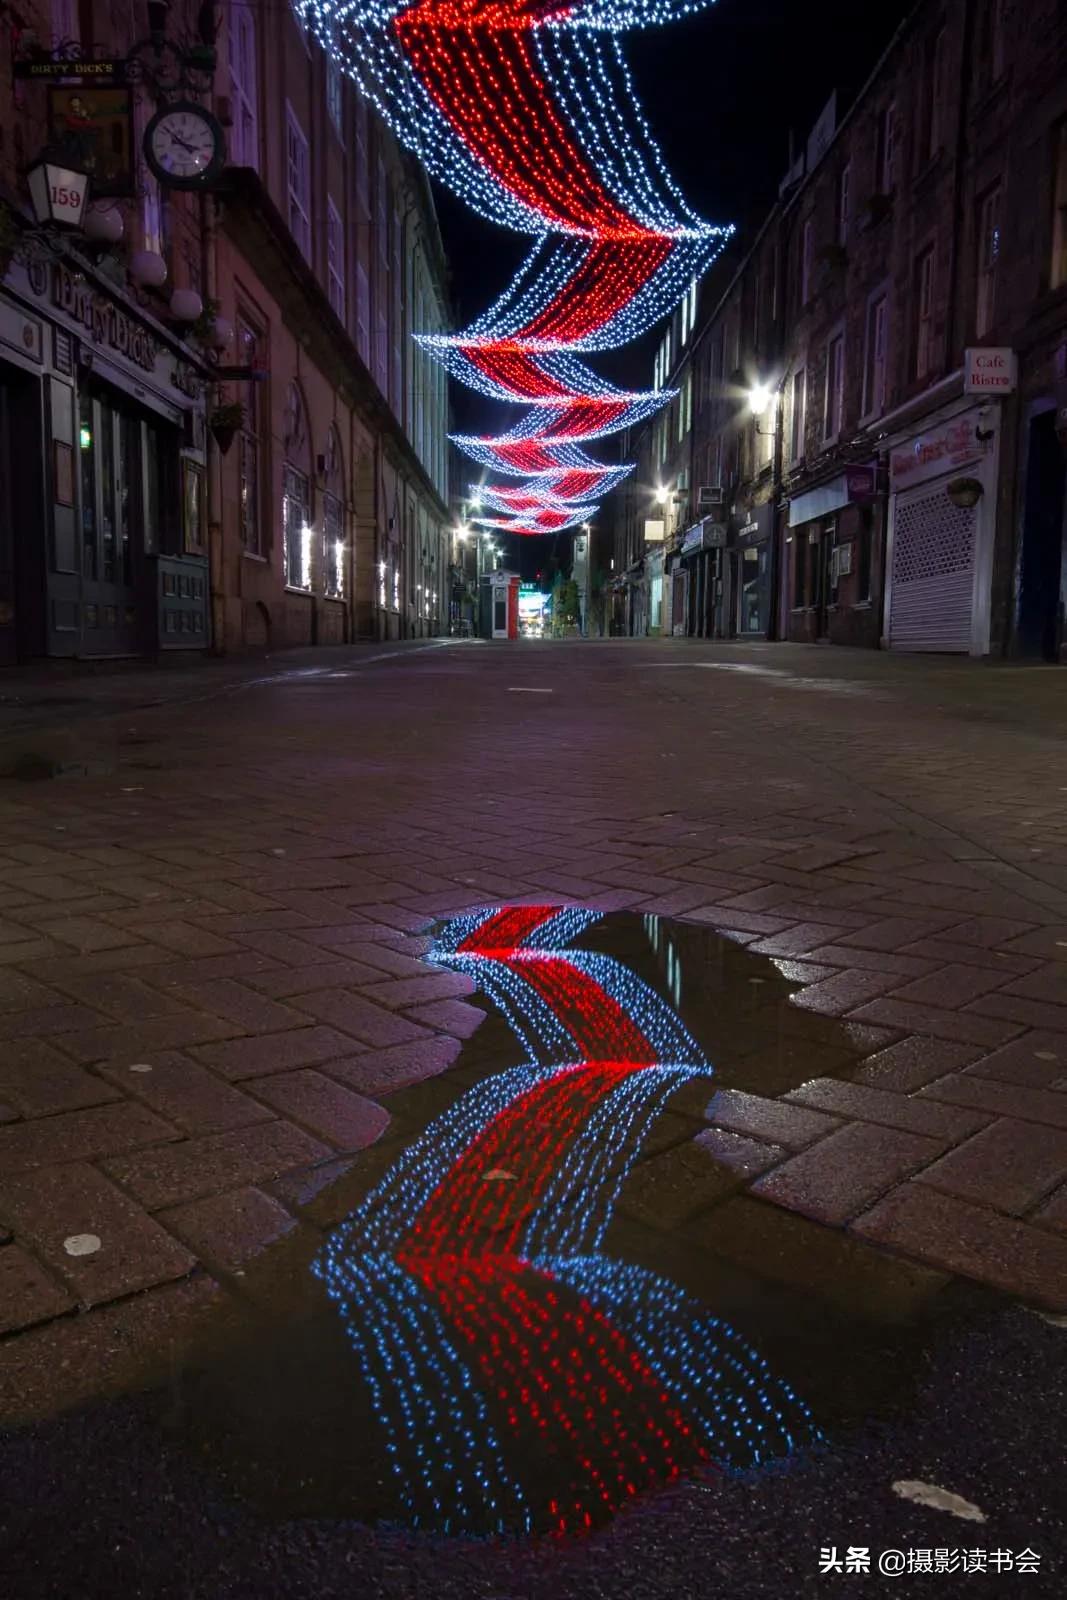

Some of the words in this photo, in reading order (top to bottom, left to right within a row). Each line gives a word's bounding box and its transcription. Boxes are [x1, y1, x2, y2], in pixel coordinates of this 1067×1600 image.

[31, 63, 69, 73] DIRTY
[75, 63, 113, 73] DICK'S
[52, 187, 81, 208] 159
[976, 356, 1005, 368] Cafe
[971, 374, 1009, 385] Bistro
